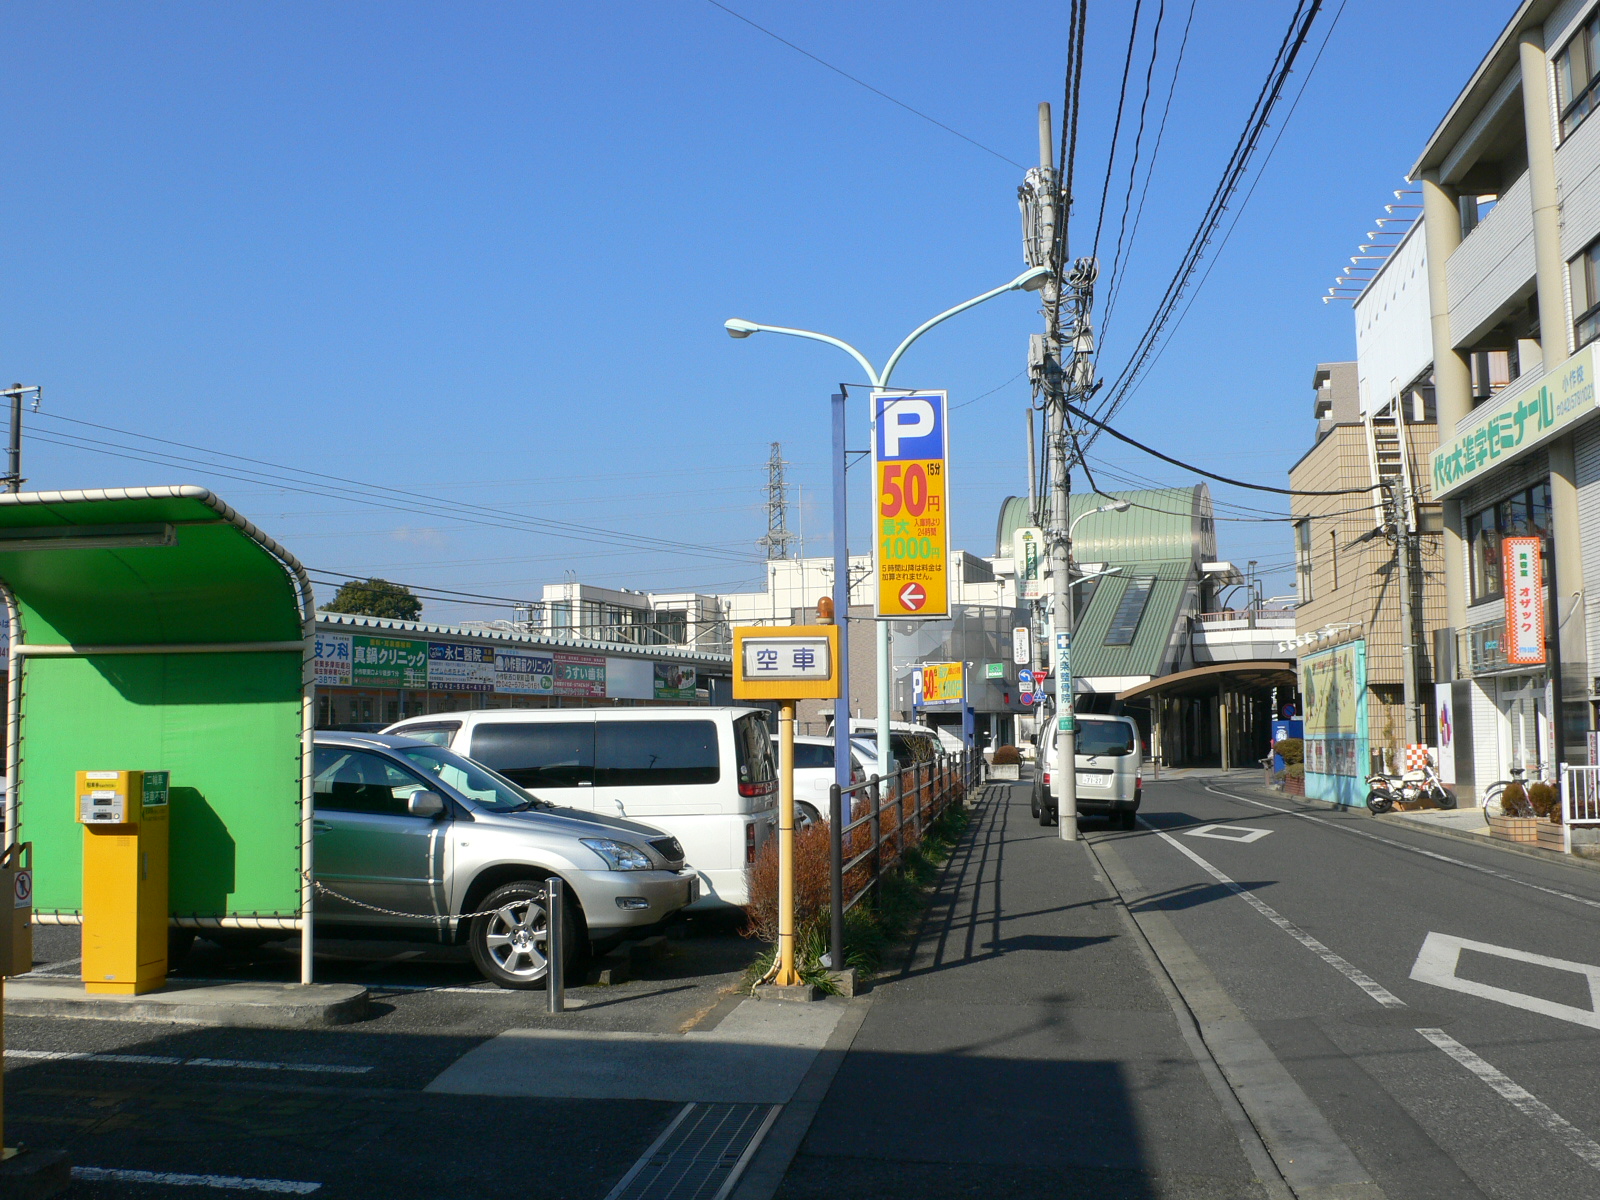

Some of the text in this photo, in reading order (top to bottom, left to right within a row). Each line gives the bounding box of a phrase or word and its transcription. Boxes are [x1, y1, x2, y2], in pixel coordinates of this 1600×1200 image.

[883, 399, 935, 457] P
[1434, 385, 1554, 491] 代々木進学ゼミナール
[927, 463, 940, 475] 15分
[883, 518, 910, 535] 最大
[917, 528, 937, 536] 24時間
[1519, 587, 1531, 631] オザック
[354, 646, 426, 667] 真鍋クリニック
[756, 646, 816, 672] 空車
[565, 665, 604, 681] うすい歯科
[912, 670, 922, 704] P
